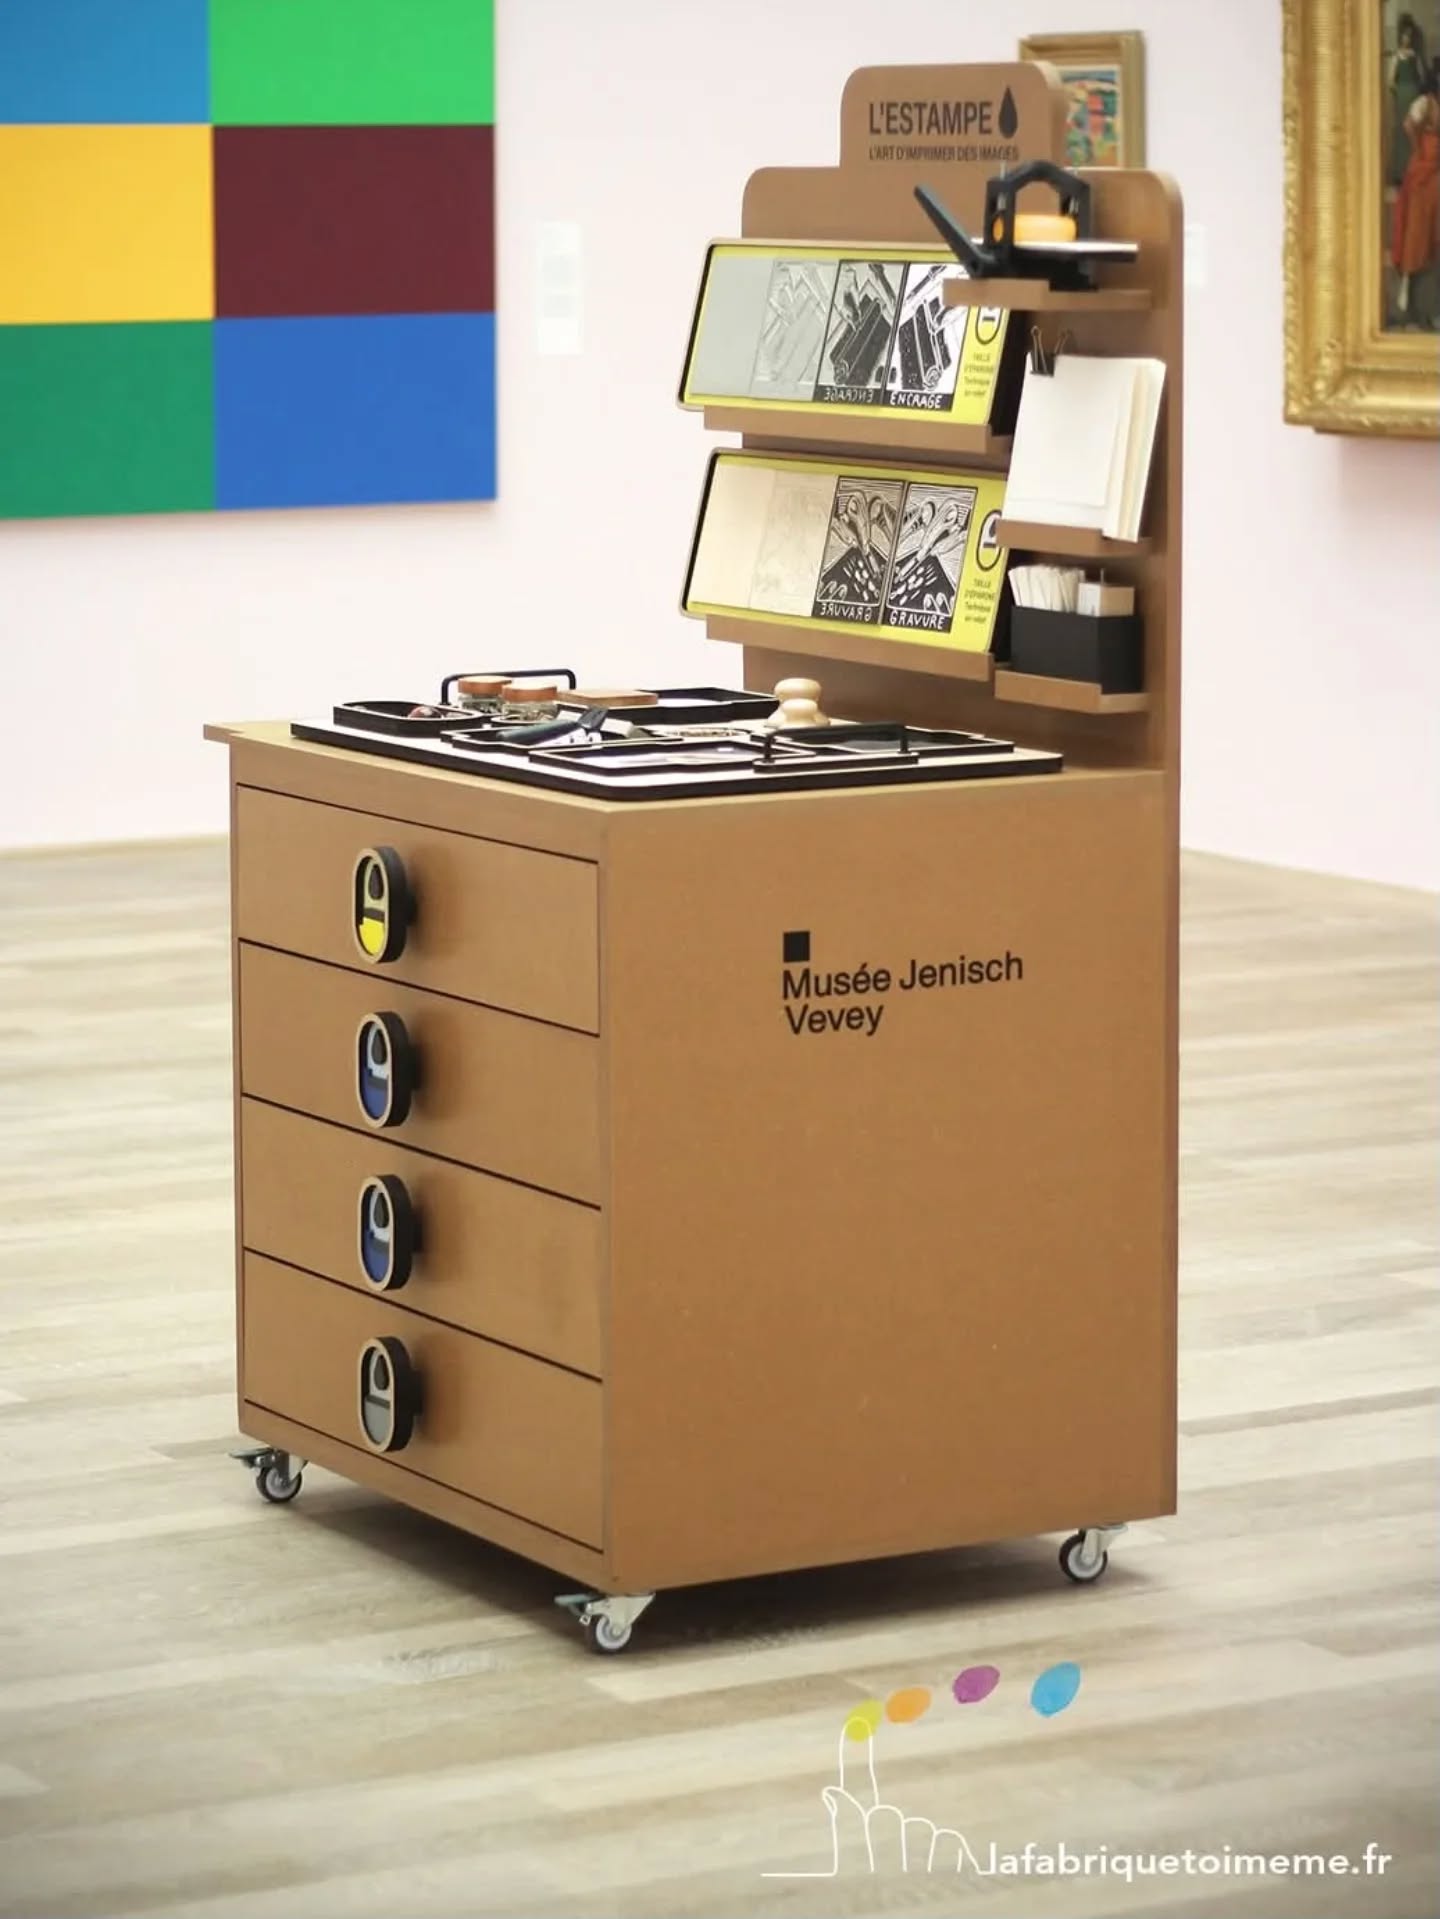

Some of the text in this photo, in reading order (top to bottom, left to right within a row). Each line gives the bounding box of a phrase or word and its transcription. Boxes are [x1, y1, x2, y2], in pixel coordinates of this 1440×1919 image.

[869, 101, 992, 135] L'ESTAMPE
[869, 145, 894, 160] L'ART
[889, 393, 942, 409] ENCRAGE
[889, 610, 945, 630] GRAVURE
[783, 951, 1023, 1000] Musée Jenisch
[784, 1003, 884, 1036] Vevey
